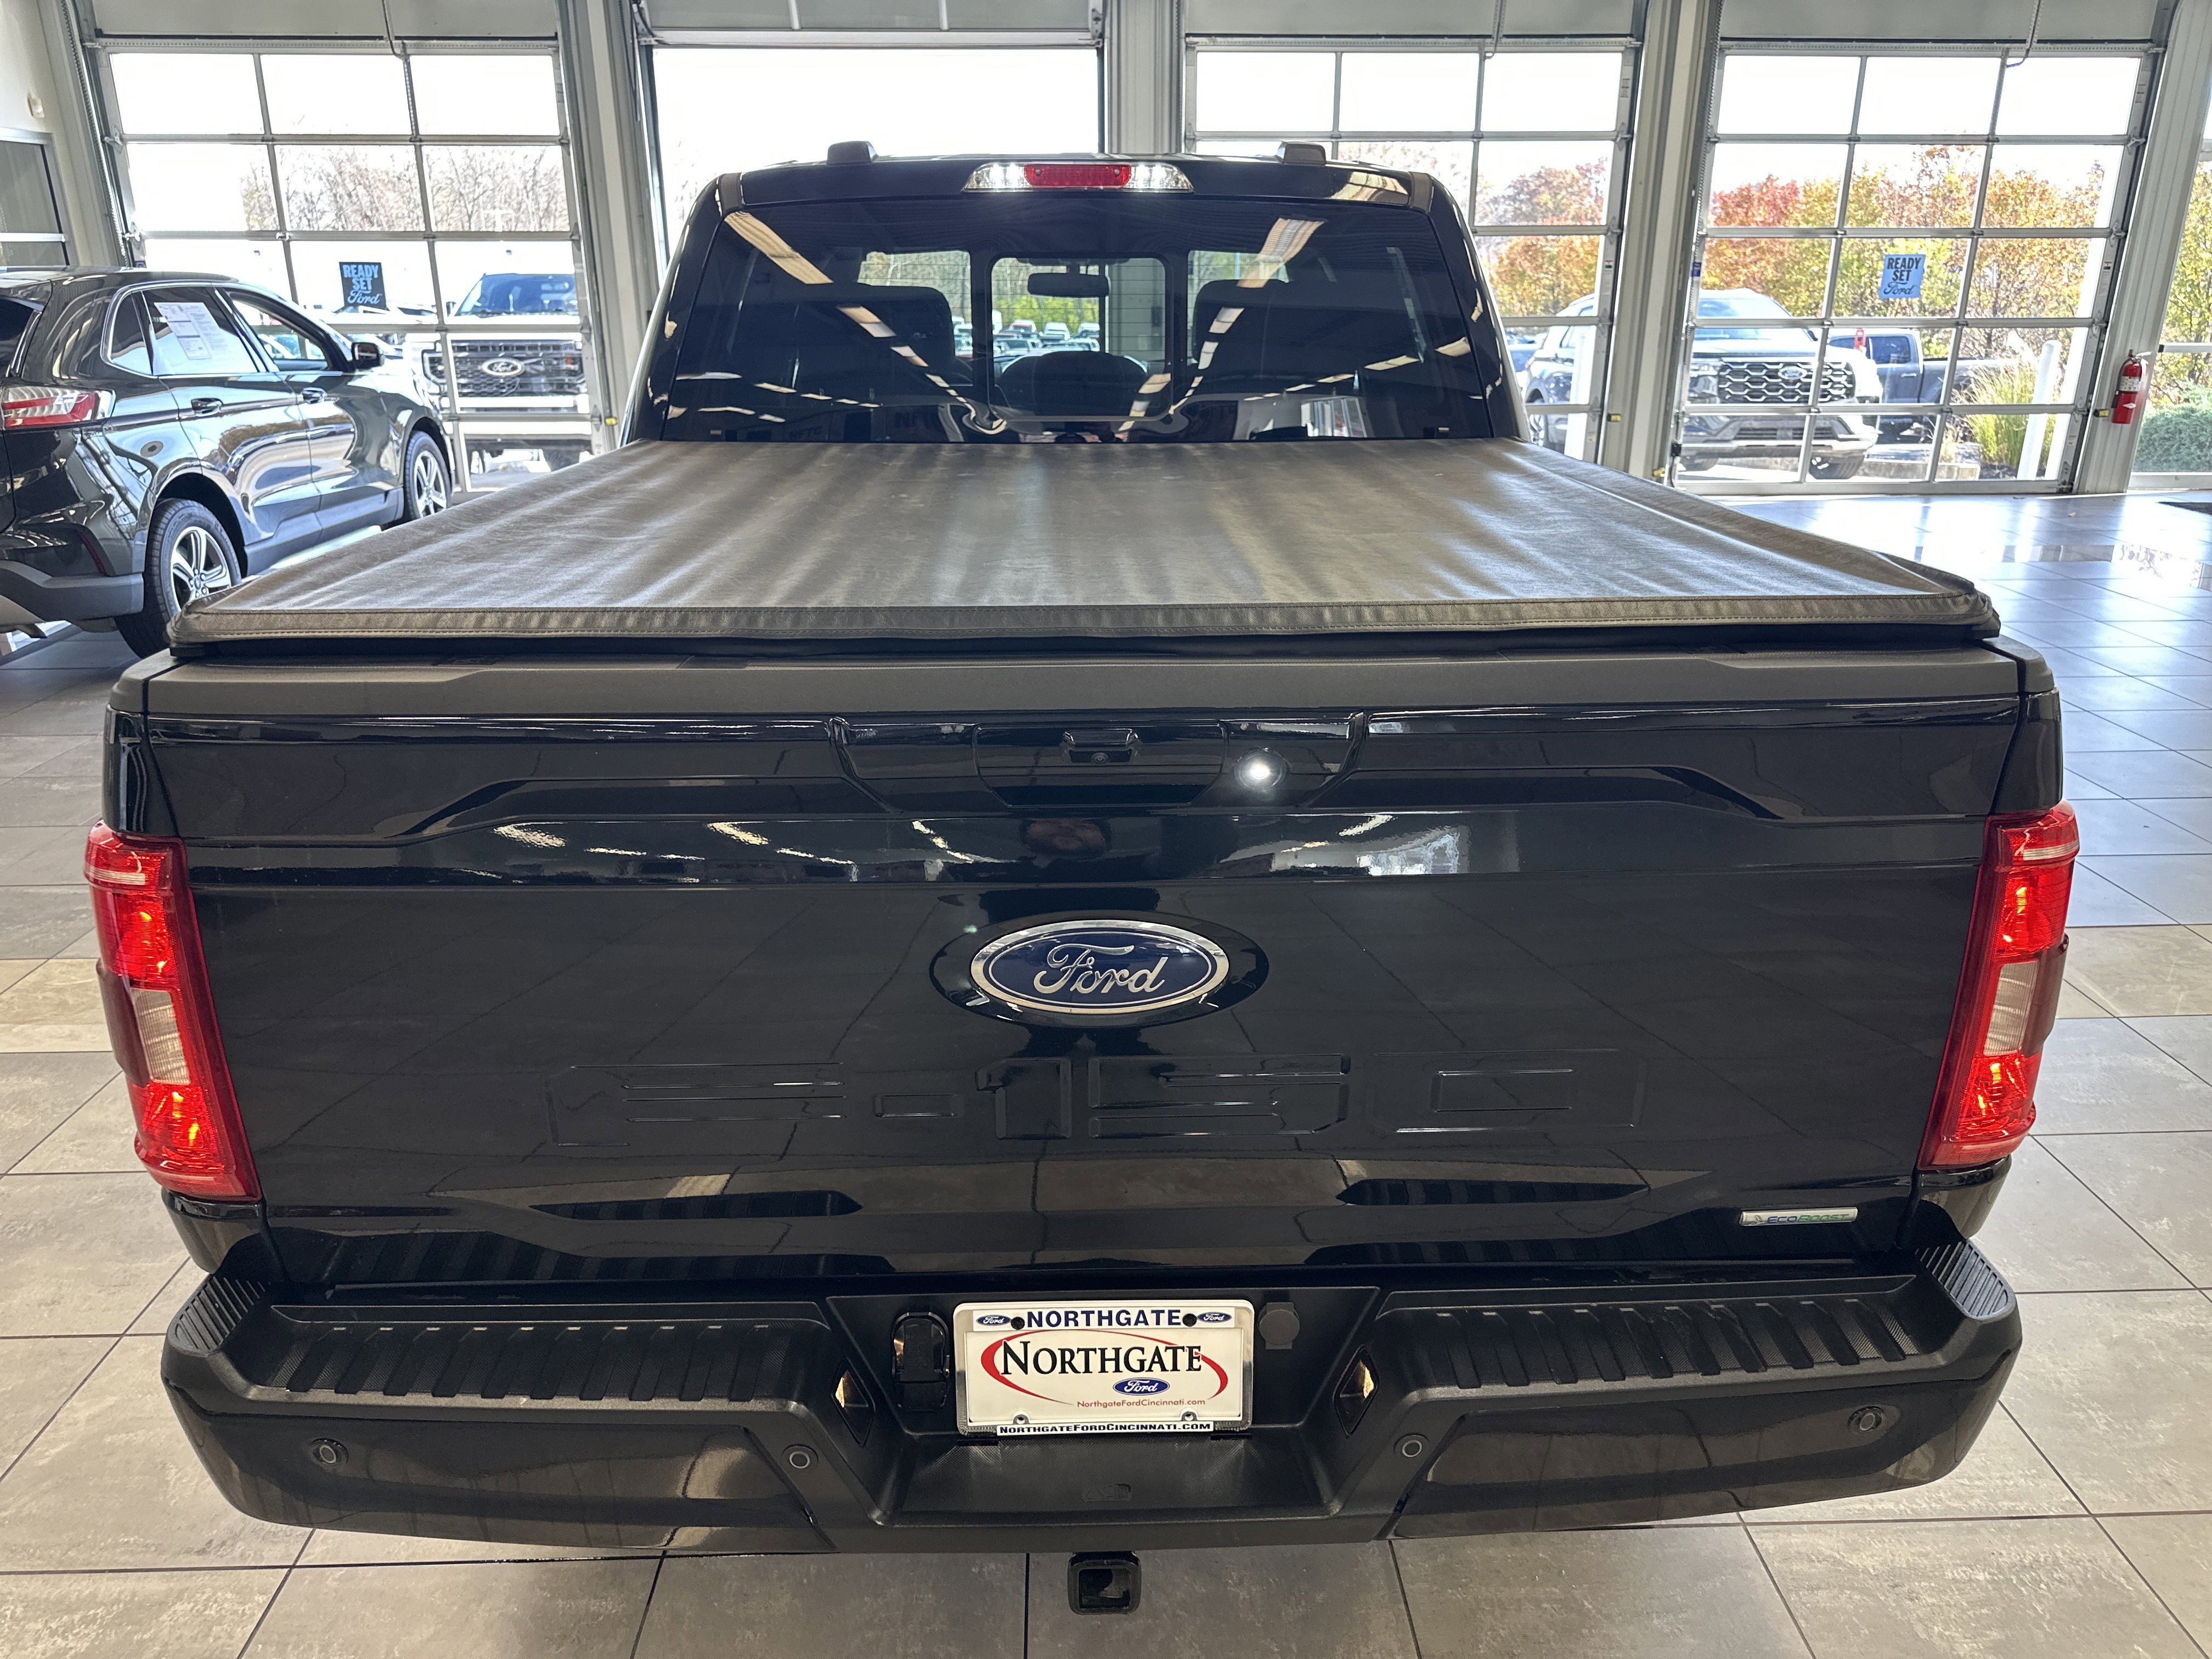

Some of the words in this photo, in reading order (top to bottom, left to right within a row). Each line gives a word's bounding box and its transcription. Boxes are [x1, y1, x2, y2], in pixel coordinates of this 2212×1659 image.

[1887, 257, 1921, 269] READY
[342, 264, 379, 278] READY
[1892, 270, 1912, 281] SET
[352, 278, 372, 290] SET
[1883, 281, 1915, 295] Ford
[347, 290, 380, 304] Ford
[1034, 943, 1169, 994] Ford
[983, 1316, 1005, 1324] Ford
[1027, 1310, 1181, 1328] NORTHGATE
[1001, 1340, 1202, 1375] NORTHGATE
[1124, 1380, 1158, 1392] Ford
[1077, 1399, 1205, 1408] NorthgateFordCincinnati.com
[1000, 1422, 1211, 1435] NORTHGATEFORDCINCINNATI.COM
